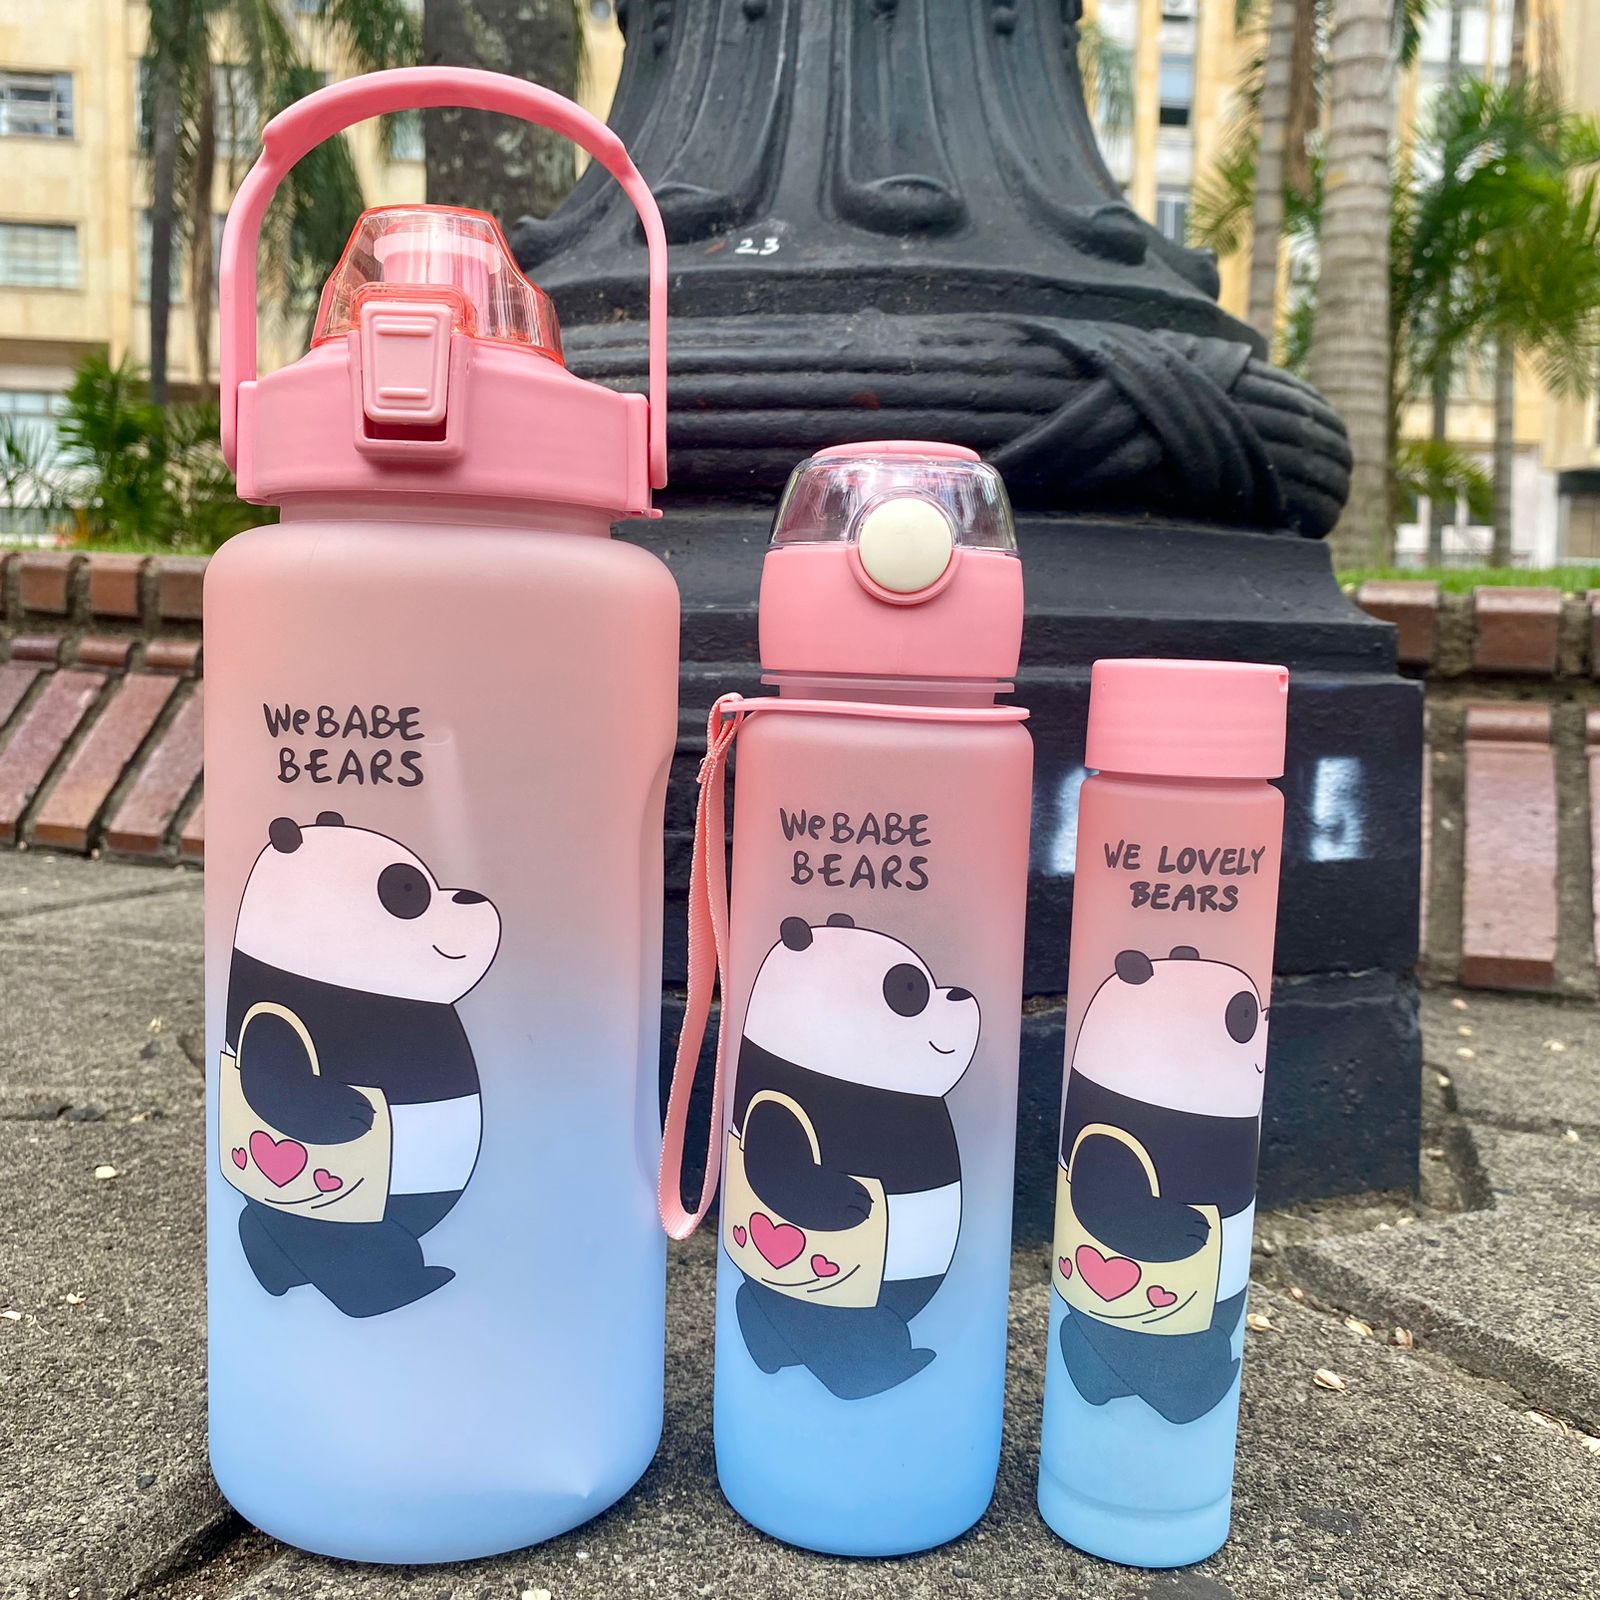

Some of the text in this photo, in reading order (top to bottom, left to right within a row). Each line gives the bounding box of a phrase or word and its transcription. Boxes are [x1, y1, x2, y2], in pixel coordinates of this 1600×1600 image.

[734, 237, 780, 256] 23
[277, 747, 424, 787] BEARS
[790, 850, 929, 892] BEARS
[1103, 839, 1266, 876] WE LOVELY
[1129, 880, 1239, 913] BEARS
